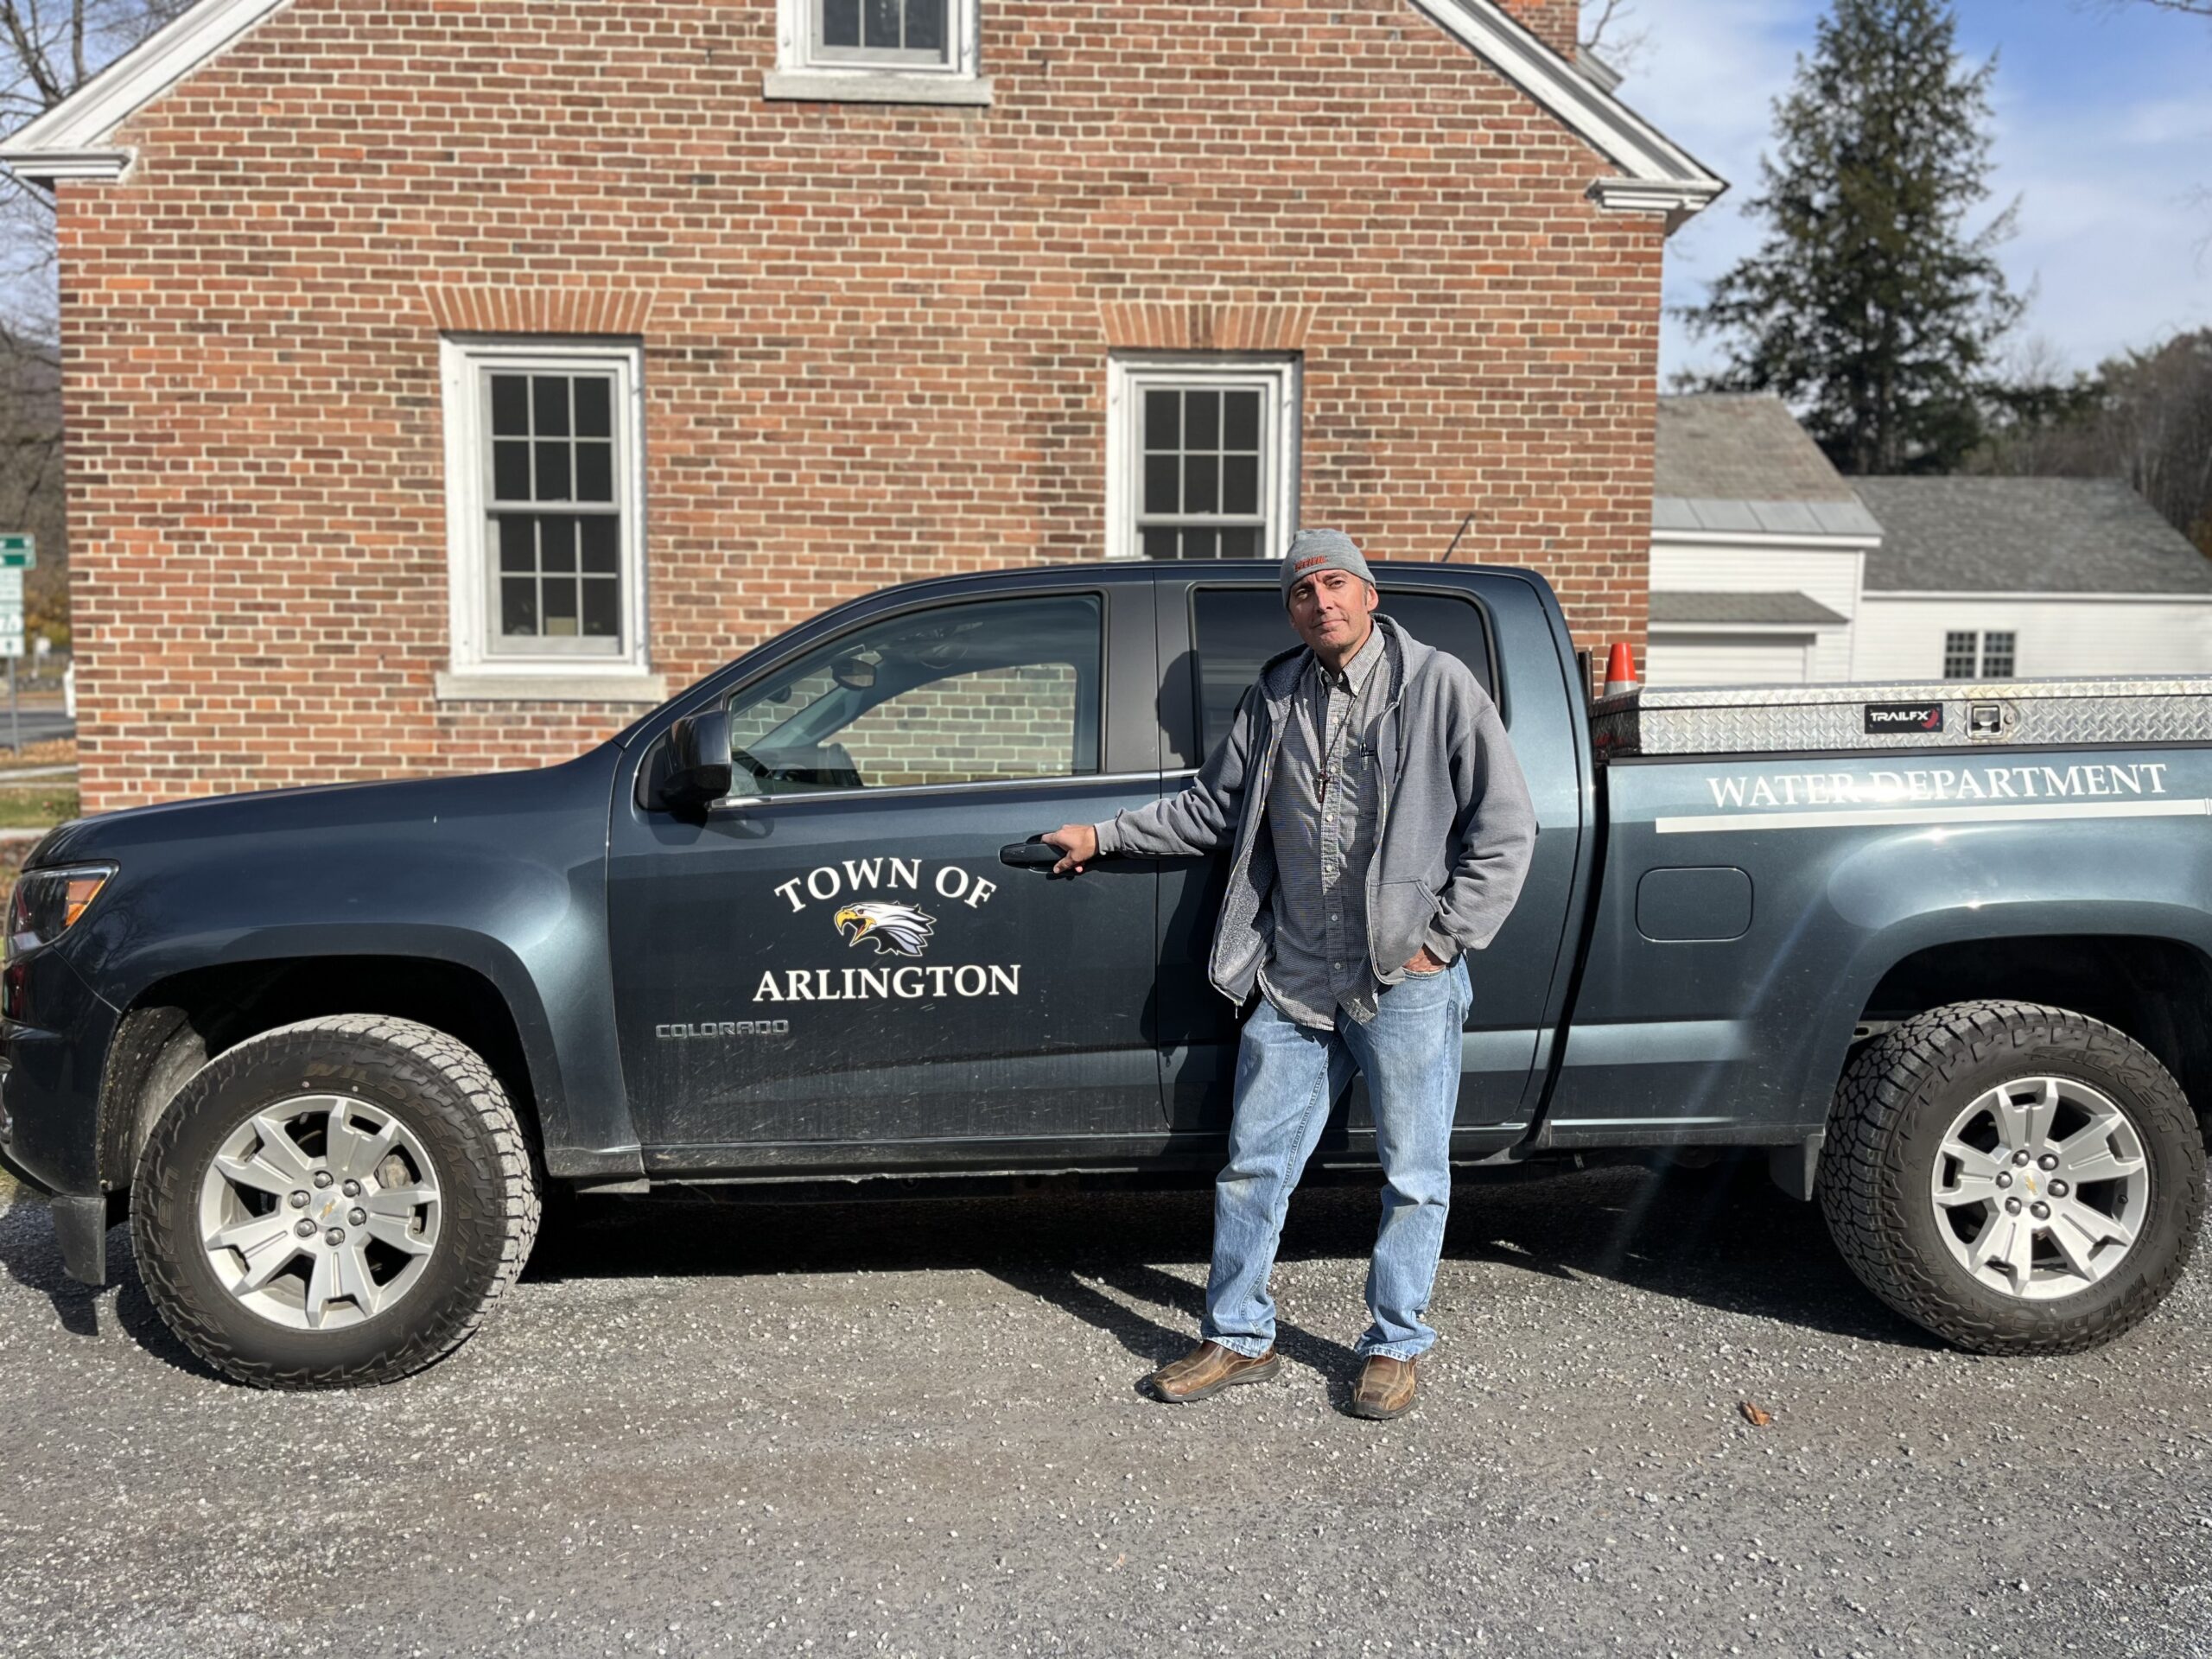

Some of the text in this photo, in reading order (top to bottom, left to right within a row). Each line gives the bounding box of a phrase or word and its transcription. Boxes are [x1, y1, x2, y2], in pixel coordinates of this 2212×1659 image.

[1870, 710, 1929, 721] TRAILFX
[1707, 763, 2167, 808] WATER DEPARTMENT
[774, 857, 997, 912] TOWN OF
[753, 964, 1021, 1001] ARLINGTON
[655, 1020, 789, 1038] COLORADO
